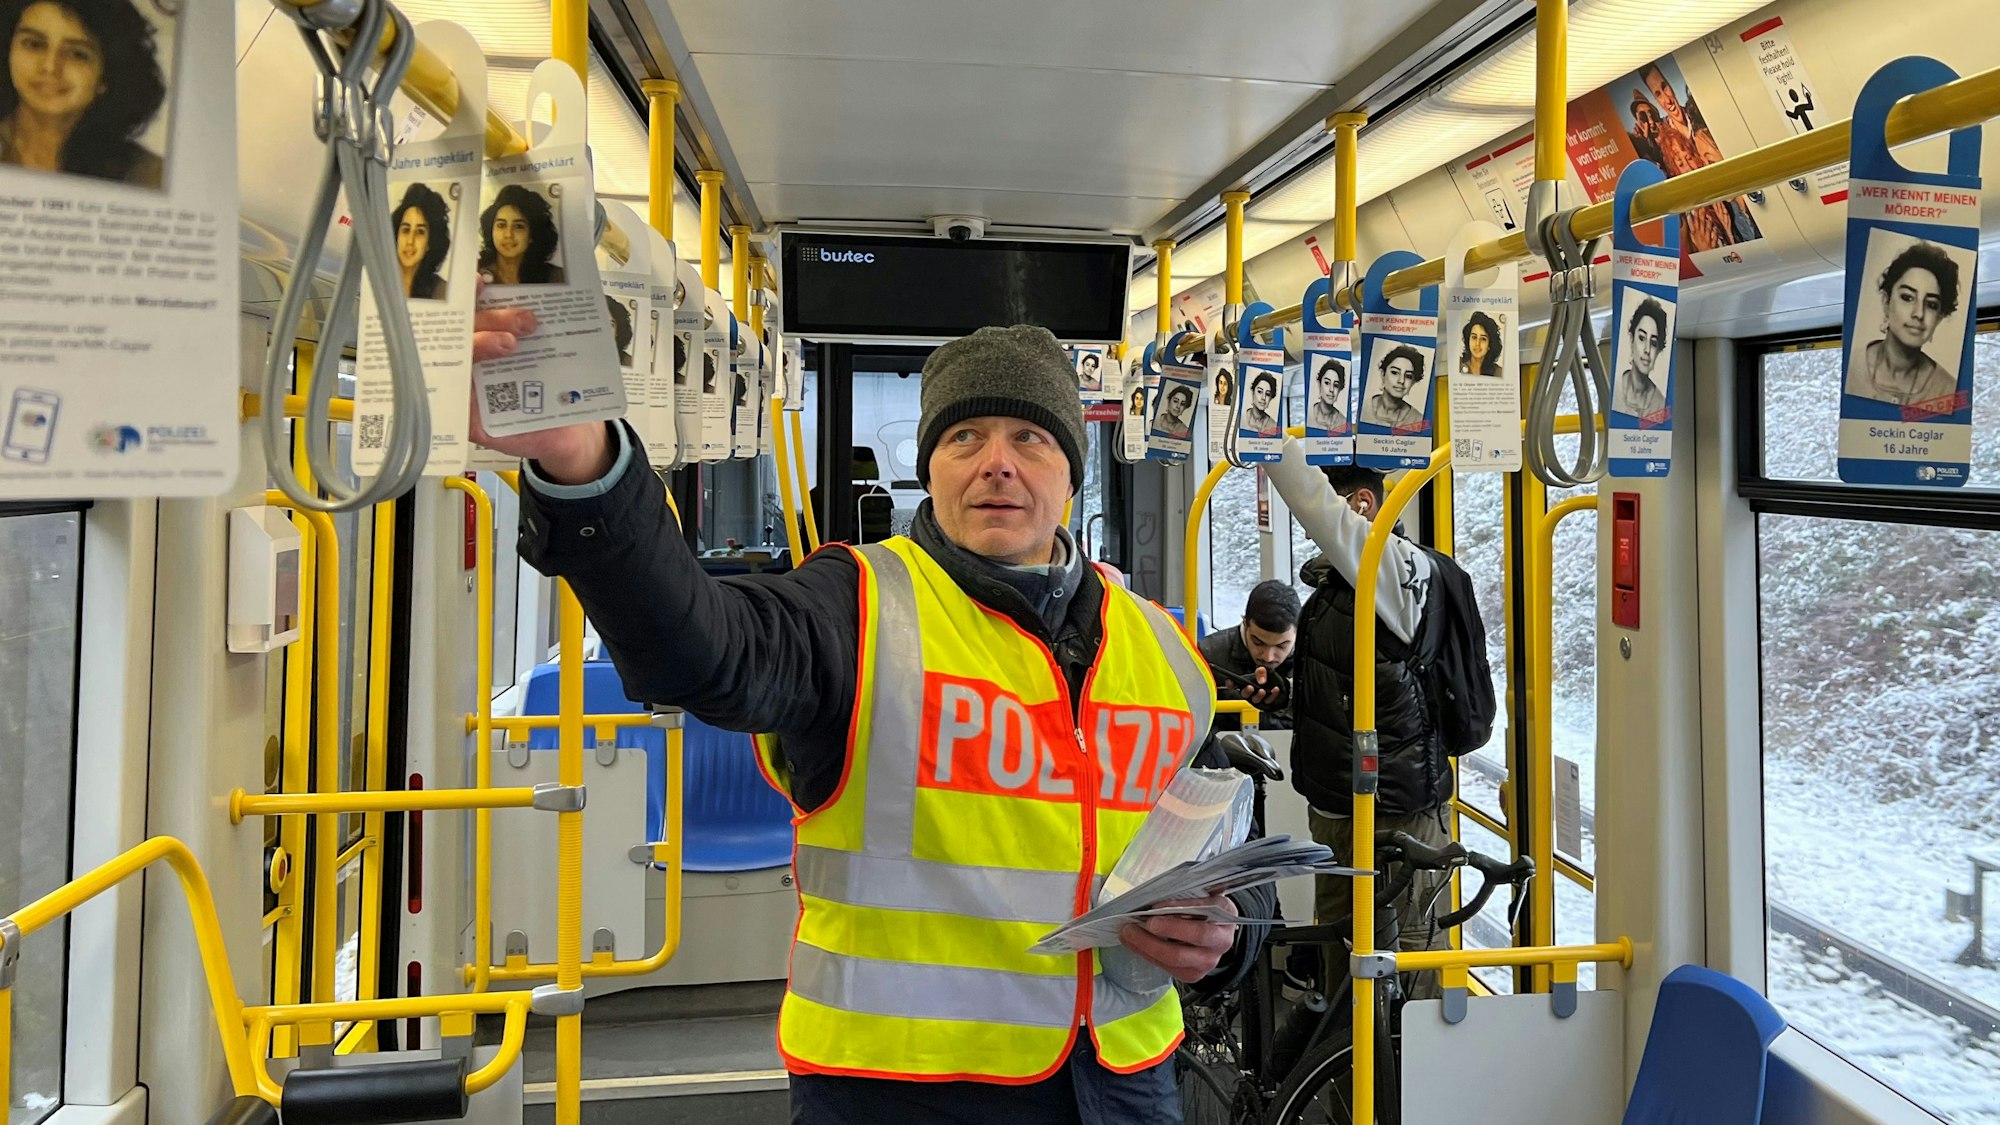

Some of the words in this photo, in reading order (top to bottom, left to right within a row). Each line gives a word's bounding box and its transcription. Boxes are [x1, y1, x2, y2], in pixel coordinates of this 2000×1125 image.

[1760, 40, 1776, 51] Bitte
[1759, 45, 1790, 64] festhalten!
[1763, 64, 1782, 76] Please
[1781, 56, 1795, 69] hold
[1776, 71, 1794, 85] tight!
[1567, 133, 1579, 147] Ihr
[1575, 121, 1607, 142] kommt
[1576, 153, 1592, 166] von
[1588, 139, 1619, 160] überall
[391, 157, 421, 170] Jahre
[424, 151, 475, 168] ungeklärt
[519, 155, 575, 173] ungeklärt
[1584, 172, 1602, 186] her.
[1598, 164, 1617, 180] Wir
[1856, 186, 1888, 198] „WER
[1891, 189, 1931, 201] KENNT
[1934, 193, 1977, 206] MEINEN
[1884, 203, 1948, 218] MÖRDER?“
[820, 247, 875, 264] bustec
[1633, 257, 1653, 268] KENNT
[1654, 260, 1678, 271] MEINEN
[609, 280, 646, 290] ungeklärt
[1452, 295, 1461, 303] 31
[1462, 296, 1481, 304] Jahre
[1482, 297, 1513, 305] ungeklärt
[1385, 317, 1408, 325] KENNT
[1409, 318, 1435, 326] MEINEN
[1373, 437, 1395, 445] Seckin
[1395, 438, 1416, 447] Caglar
[1623, 433, 1646, 444] Seckin
[1647, 434, 1660, 446] Caglar
[1869, 427, 1906, 439] Seckin
[1908, 429, 1944, 442] Caglar
[1638, 446, 1652, 455] Jahre
[1883, 443, 1896, 454] 16
[1898, 445, 1929, 455] Jahre
[934, 682, 1193, 805] POLIZEI
